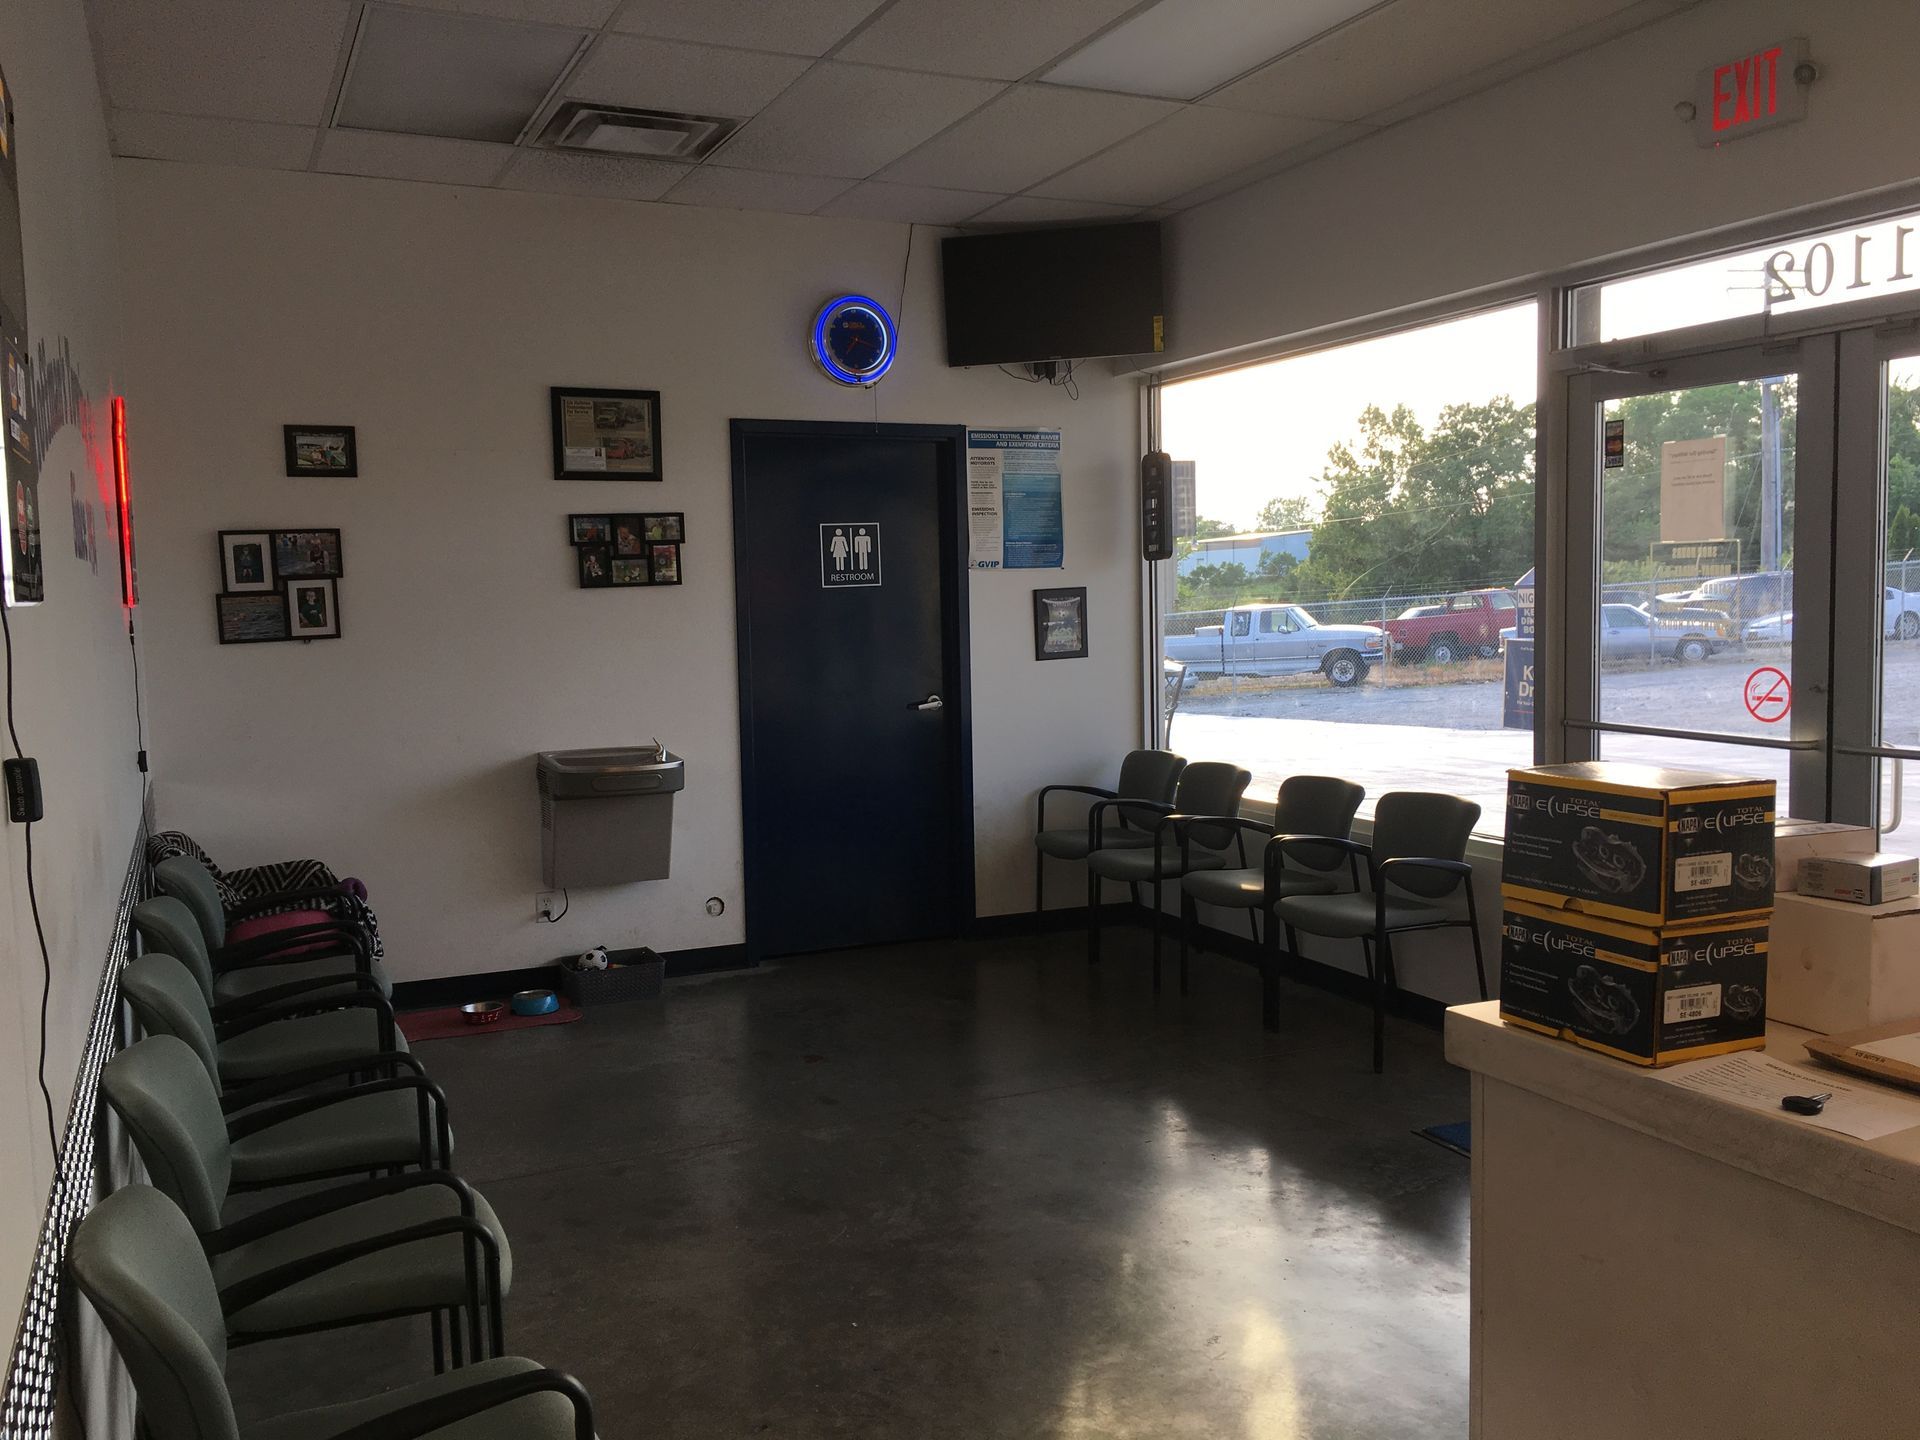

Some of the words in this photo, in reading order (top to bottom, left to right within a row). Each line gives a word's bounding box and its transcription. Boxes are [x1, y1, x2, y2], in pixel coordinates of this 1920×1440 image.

[1712, 47, 1782, 132] EXIT
[970, 432, 999, 440] EMISSIONS
[977, 560, 1000, 568] GVIP
[831, 573, 874, 582] RESTROOM
[1518, 593, 1534, 604] NIG
[1523, 625, 1534, 634] BO
[16, 797, 25, 816] Switch
[1513, 795, 1530, 810] NAPA
[1570, 798, 1600, 807] TOTAL
[1737, 806, 1764, 814] TOTAL
[1681, 817, 1699, 833] NAPA
[1509, 925, 1527, 941] NAPA
[1566, 934, 1595, 946] TOTAL
[1671, 950, 1688, 966] NAPA
